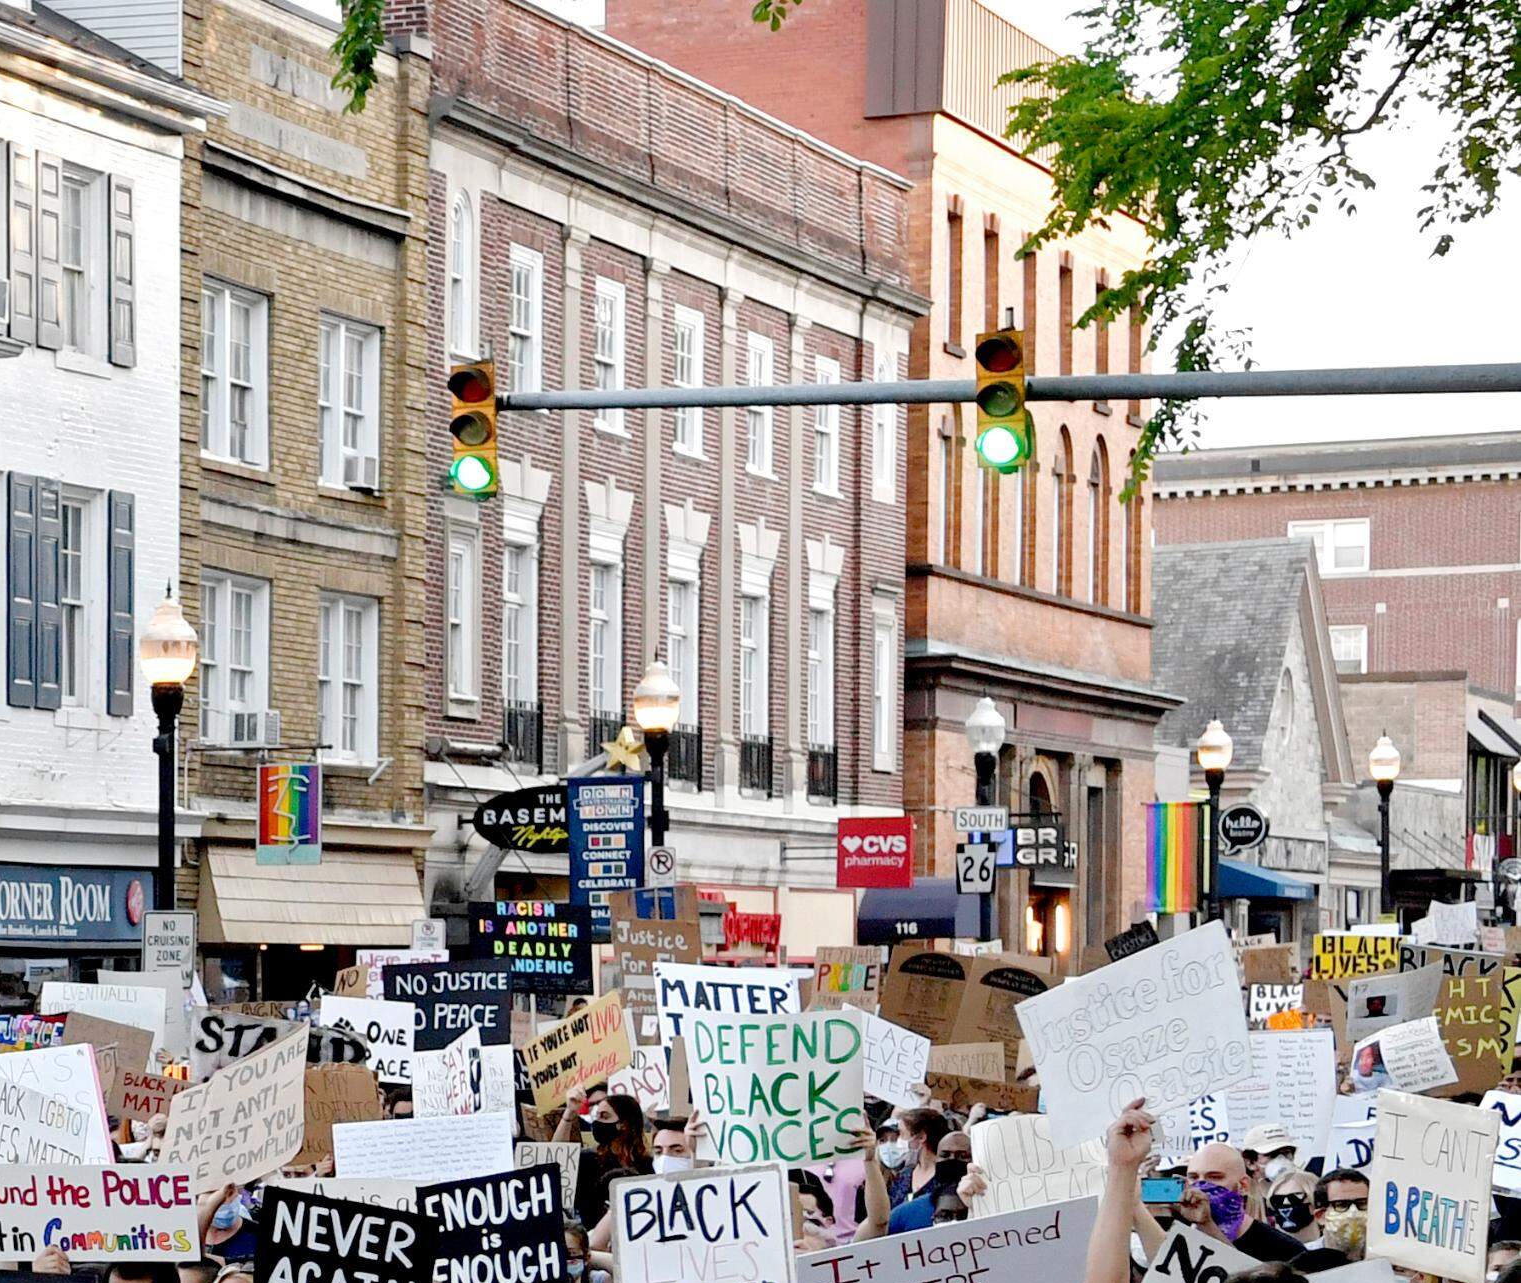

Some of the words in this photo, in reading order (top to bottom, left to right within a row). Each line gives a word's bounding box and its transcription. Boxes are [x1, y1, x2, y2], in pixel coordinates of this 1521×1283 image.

[539, 794, 561, 804] THE
[583, 822, 634, 832] DISCOVER
[959, 811, 1003, 828] SOUTH
[862, 834, 907, 853] CVS
[1017, 827, 1057, 845] BR
[583, 850, 632, 861] CONNECT
[844, 854, 905, 869] pharmacy
[1017, 848, 1057, 865] GR
[962, 856, 991, 883] 26
[578, 878, 637, 889] CELEBRATE
[59, 876, 111, 926] ROOM
[496, 902, 555, 917] RACISM
[162, 919, 176, 931] NO
[479, 919, 494, 934] IS
[505, 921, 578, 937] ANOTHER
[617, 921, 688, 951] Justice
[895, 922, 918, 935] 116
[147, 935, 191, 946] CRUISING
[494, 941, 572, 957] DEADLY
[156, 950, 181, 961] ZONE
[621, 952, 647, 973] For
[1315, 955, 1379, 974] LIVES
[337, 970, 359, 992] NO
[395, 974, 427, 996] NO
[432, 971, 508, 995] JUSTICE
[817, 963, 877, 992] PRIDE
[434, 1003, 499, 1030] PEACE
[1026, 978, 1155, 1065] Justice
[1161, 949, 1225, 1003] for
[366, 1021, 407, 1046] ONE
[693, 1019, 862, 1067] DEFEND
[1068, 1017, 1190, 1092] Osaze
[123, 1072, 165, 1093] BLACK
[703, 1070, 843, 1116] BLACK
[38, 1096, 84, 1136] LGBTQ
[168, 1124, 254, 1165] RACIST
[263, 1103, 297, 1138] YOU
[702, 1106, 864, 1164] VOICES
[519, 1144, 577, 1168] BLACK
[45, 1175, 91, 1208] the
[102, 1169, 192, 1208] POLICE
[624, 1176, 769, 1243] BLACK
[1384, 1180, 1480, 1257] BREATHE
[14, 1226, 35, 1253] in
[42, 1218, 193, 1252] Communities
[272, 1200, 416, 1269] NEVER
[481, 1229, 503, 1251] is
